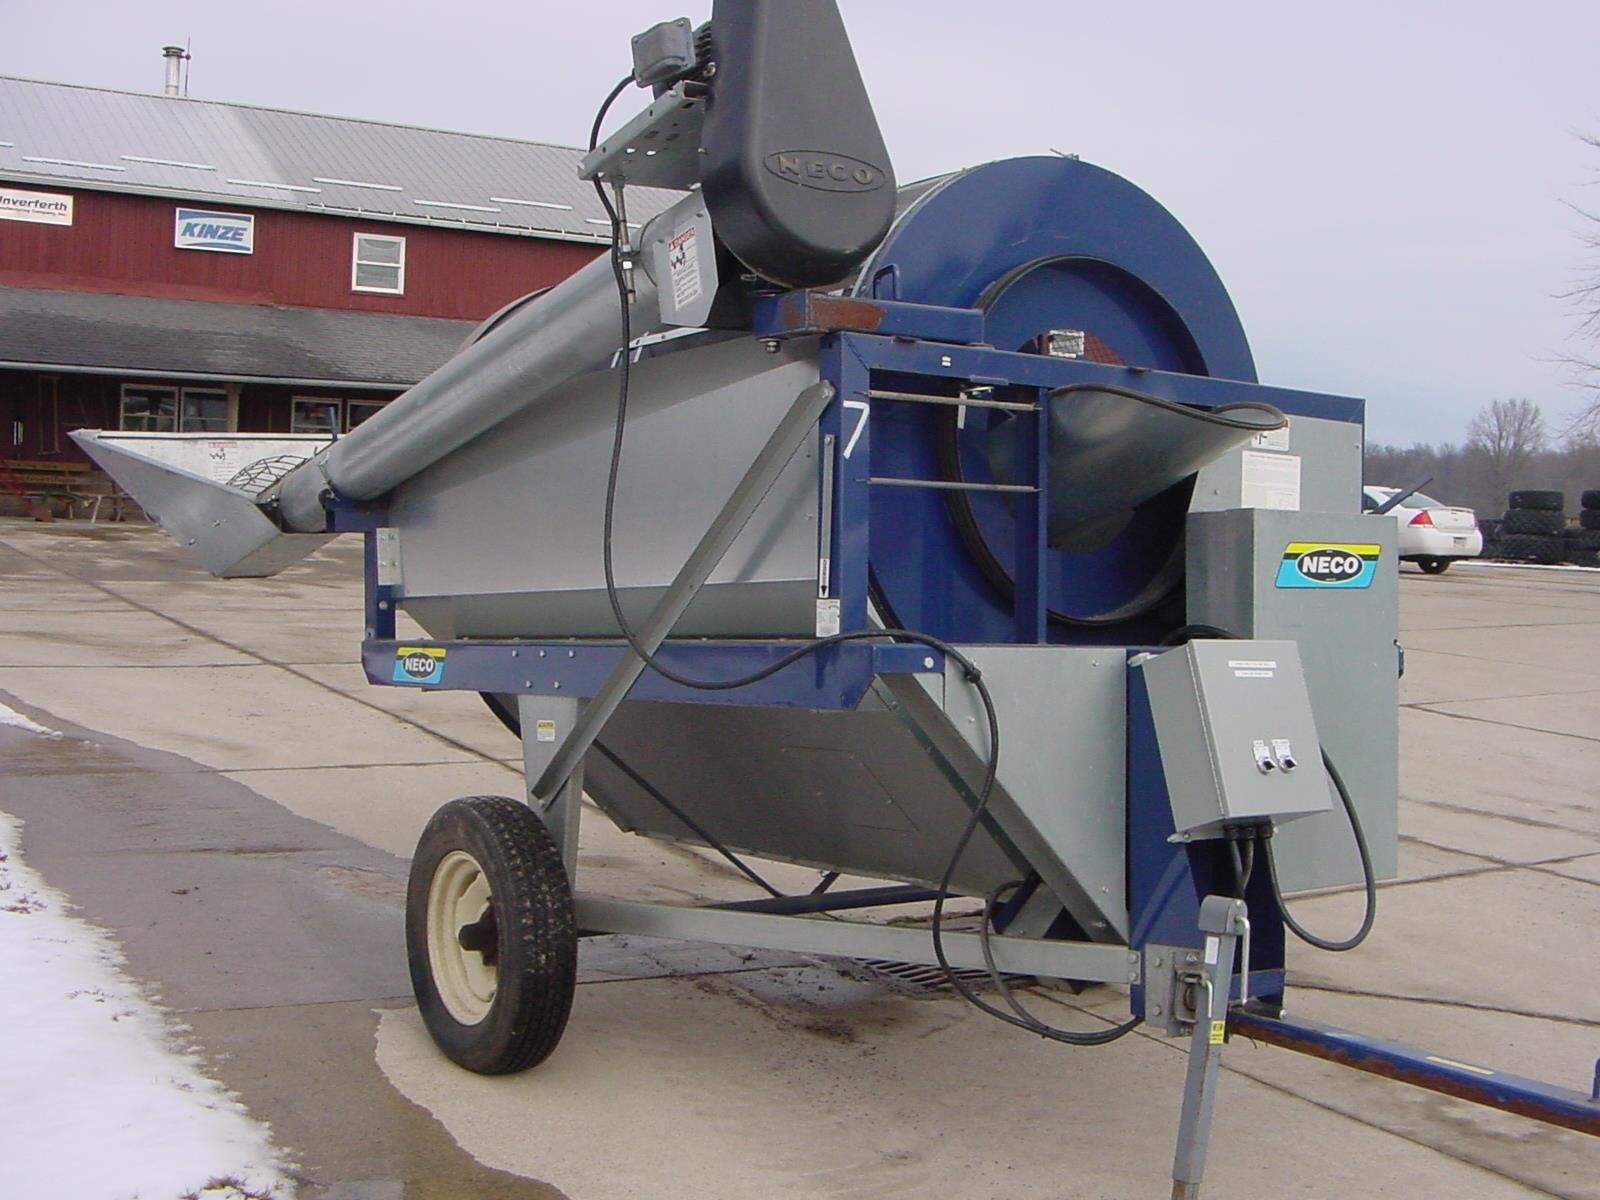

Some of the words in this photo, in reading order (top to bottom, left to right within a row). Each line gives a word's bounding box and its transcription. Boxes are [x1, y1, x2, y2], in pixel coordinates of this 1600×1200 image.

[777, 155, 873, 185] NECO
[181, 222, 248, 241] KINZE
[1302, 556, 1359, 574] NECO
[405, 658, 434, 672] NECO
